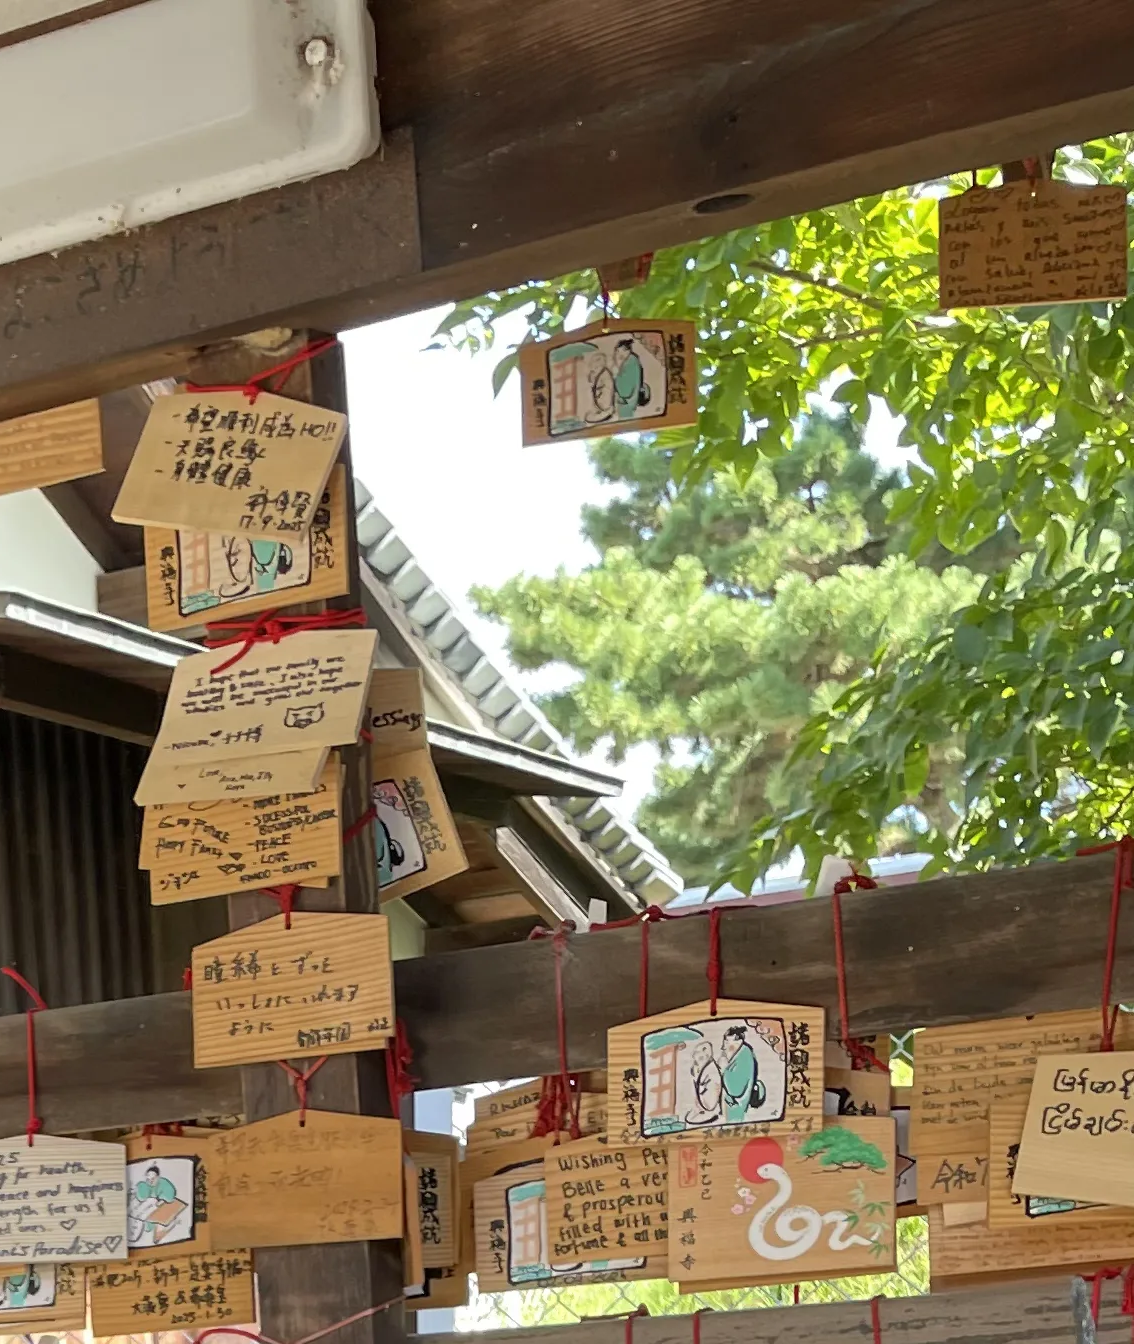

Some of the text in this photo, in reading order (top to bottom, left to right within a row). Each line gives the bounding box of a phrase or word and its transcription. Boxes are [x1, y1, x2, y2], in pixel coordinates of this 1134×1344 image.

[622, 1068, 640, 1127] 興福寺
[558, 1151, 626, 1171] Wishing
[36, 1184, 61, 1198] and
[562, 1178, 606, 1199] Belle
[620, 1177, 630, 1190] a
[560, 1211, 651, 1242] filled with
